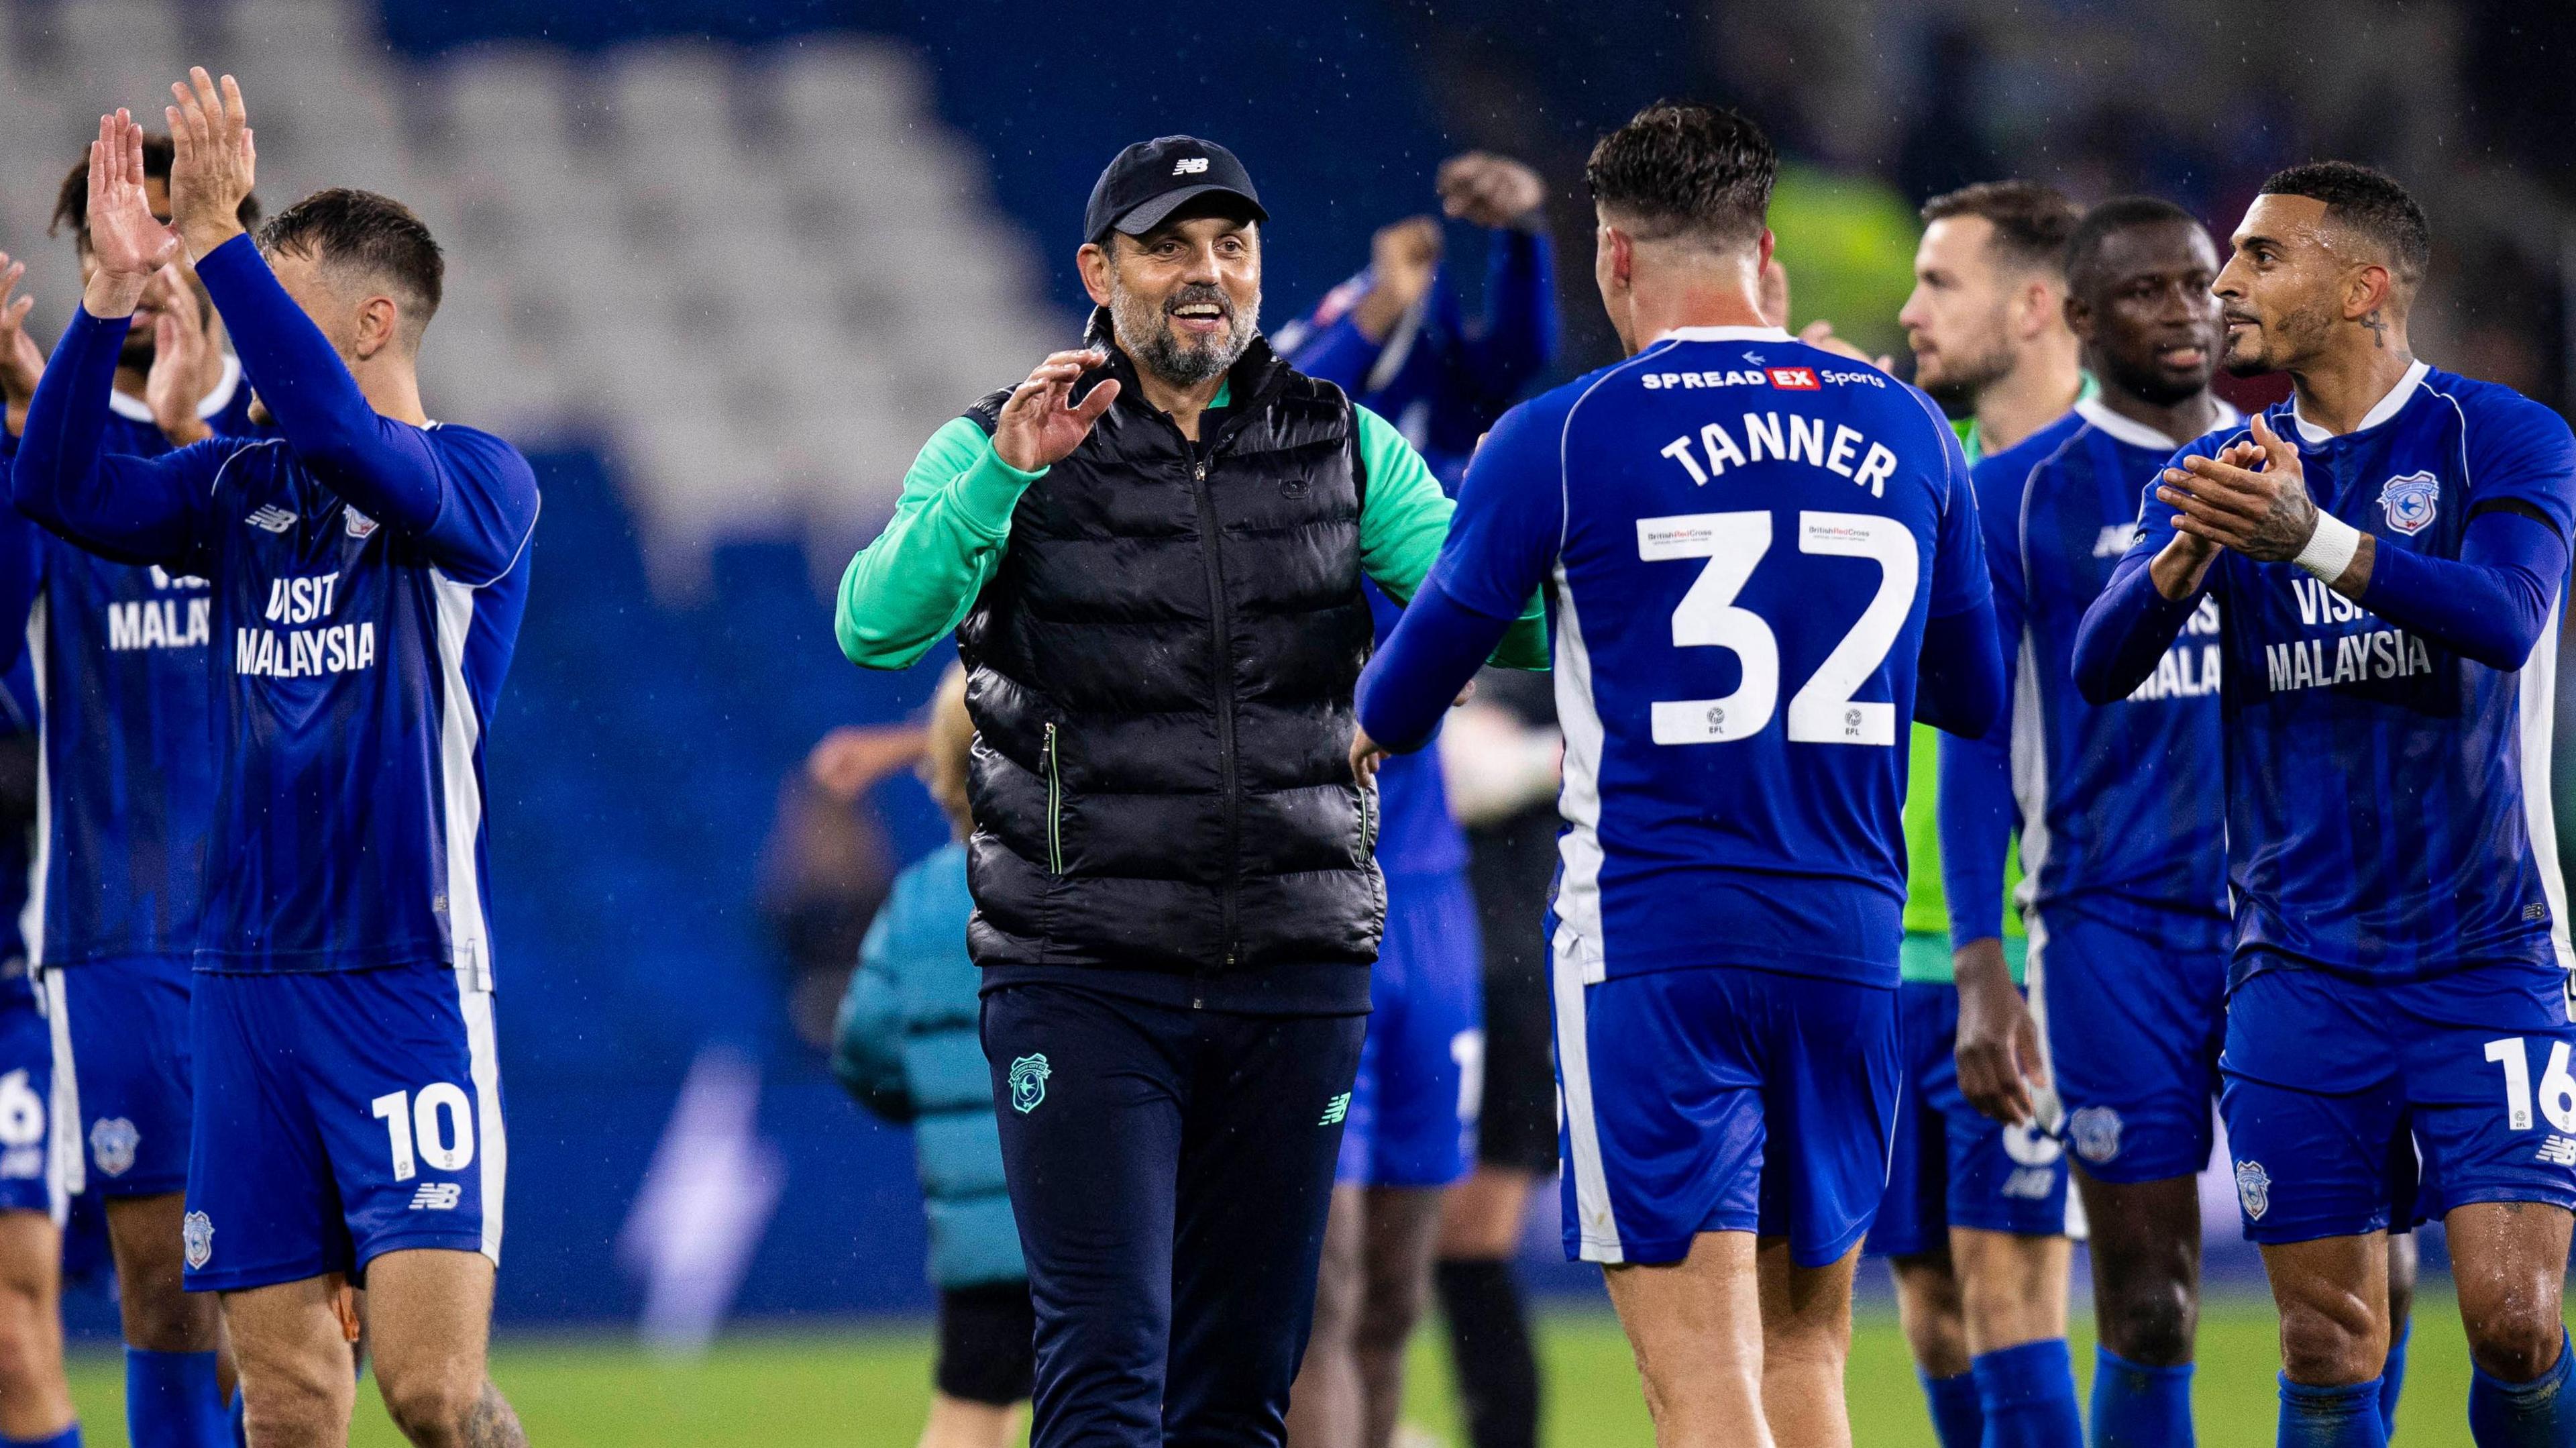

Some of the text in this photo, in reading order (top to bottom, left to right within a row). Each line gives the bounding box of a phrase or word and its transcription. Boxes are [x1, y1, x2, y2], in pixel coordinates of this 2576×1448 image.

[1172, 158, 1209, 176] NB
[1641, 370, 1886, 390] SPREAD EX Sports
[1660, 411, 1897, 498] TANNER
[265, 571, 339, 625] VISIT
[1635, 510, 1919, 746] 32
[236, 622, 374, 678] MALAYSIA
[2265, 629, 2432, 692] MALAYSIA
[2483, 1037, 2576, 1134] 16
[372, 1082, 474, 1182] 10
